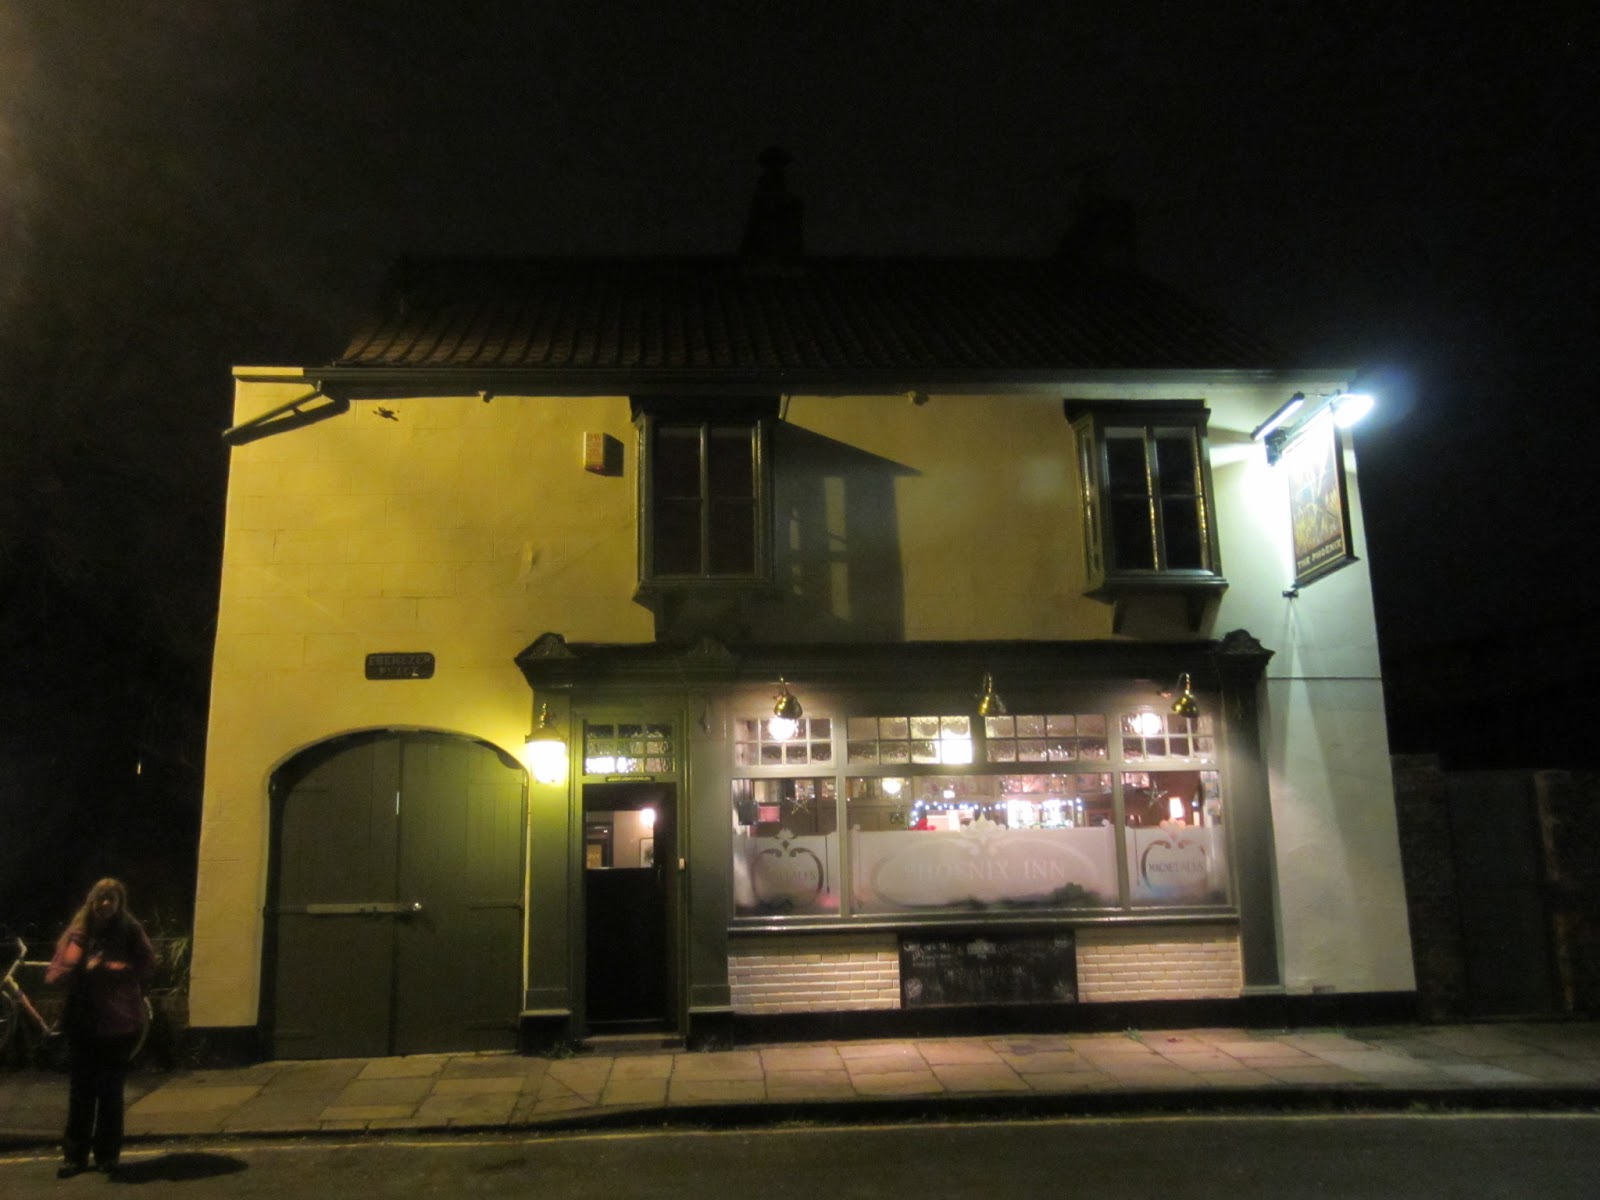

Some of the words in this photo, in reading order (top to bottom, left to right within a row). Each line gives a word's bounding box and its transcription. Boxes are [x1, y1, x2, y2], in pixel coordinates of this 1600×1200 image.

[1297, 556, 1310, 569] THE
[1312, 538, 1342, 562] PHOENIX
[1024, 859, 1065, 881] INN
